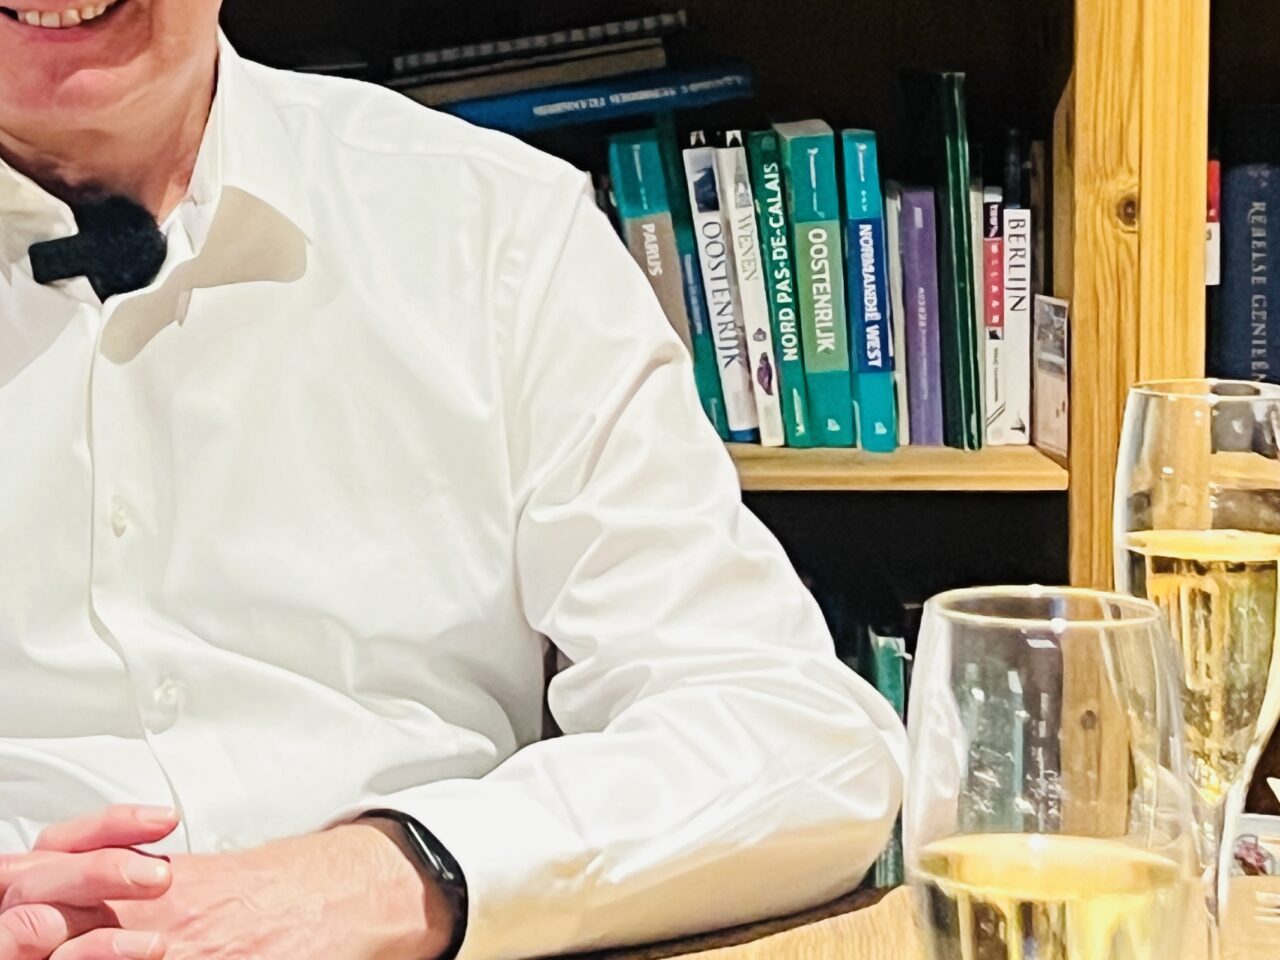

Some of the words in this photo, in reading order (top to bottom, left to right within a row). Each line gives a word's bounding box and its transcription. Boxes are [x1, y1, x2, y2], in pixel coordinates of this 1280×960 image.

[641, 222, 664, 278] PARIJS
[733, 217, 761, 282] WENEN
[1005, 217, 1027, 313] BERLIJN
[699, 220, 742, 369] OOSTENRIJK
[805, 226, 838, 355] OOSTENRIJK
[779, 303, 800, 362] NORD
[864, 324, 883, 368] WEST
